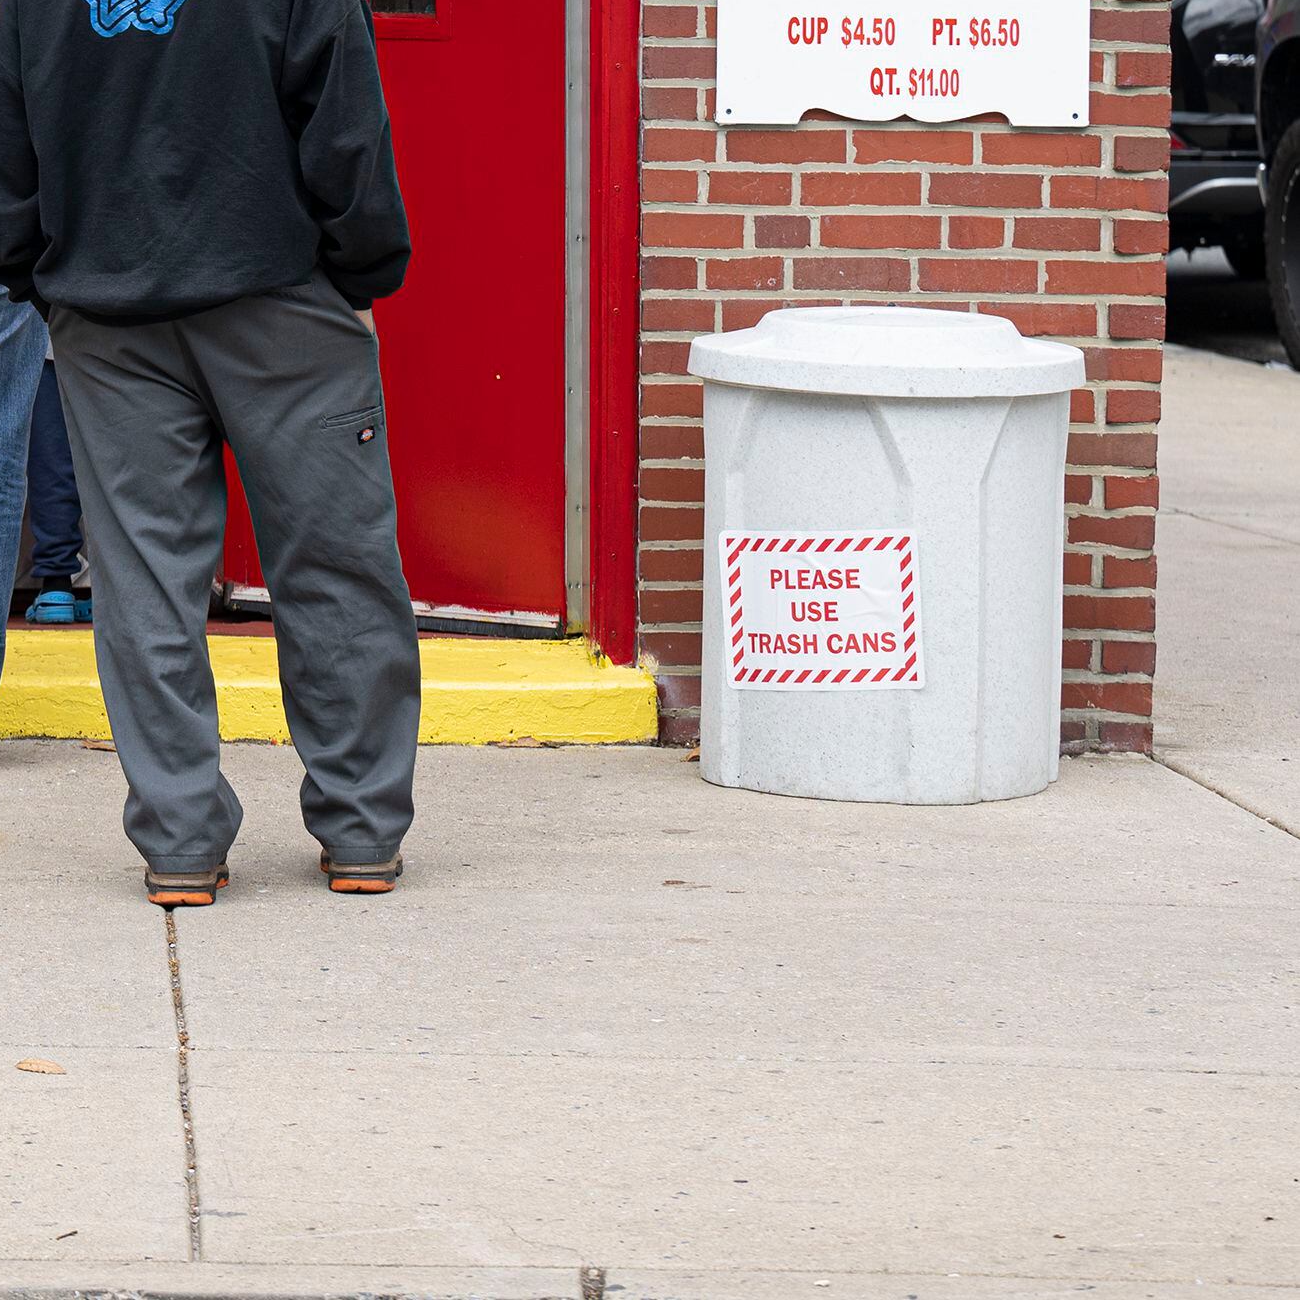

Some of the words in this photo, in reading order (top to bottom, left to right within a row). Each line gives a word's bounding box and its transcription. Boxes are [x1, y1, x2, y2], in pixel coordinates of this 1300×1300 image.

[788, 17, 828, 44] CUP
[842, 18, 895, 45] $4.50
[932, 18, 960, 45] PT.
[969, 18, 1019, 47] $6.50
[870, 67, 900, 96] QT.
[909, 68, 959, 97] $11.00
[770, 569, 860, 589] PLEASE
[792, 601, 838, 622] USE
[748, 633, 818, 654] TRASH
[827, 632, 896, 654] CANS
